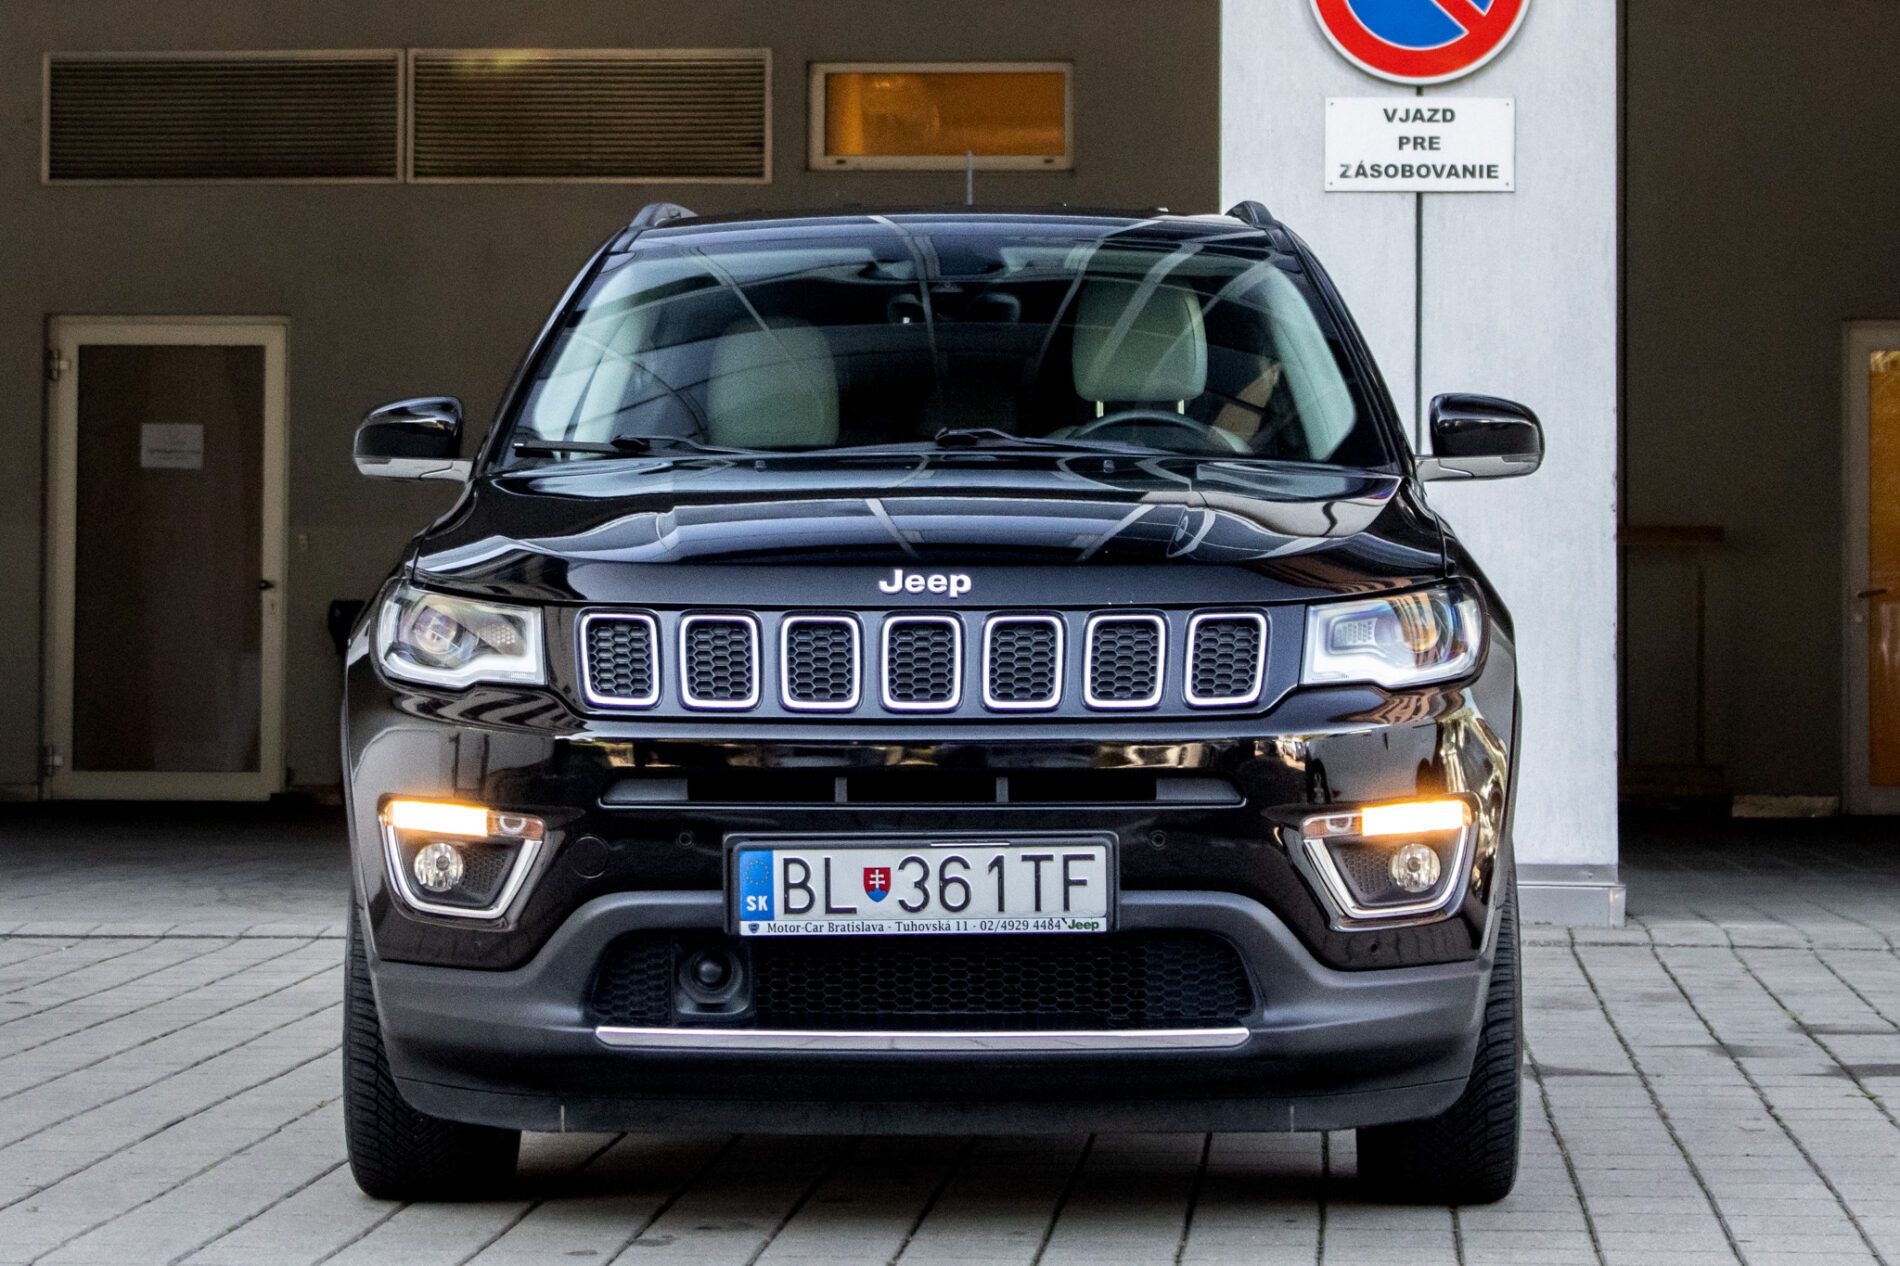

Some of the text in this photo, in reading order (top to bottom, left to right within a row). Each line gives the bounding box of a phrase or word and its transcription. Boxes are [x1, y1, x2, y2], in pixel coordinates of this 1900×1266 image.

[1383, 108, 1456, 123] VJAZD
[1398, 136, 1441, 151] PRE
[1339, 160, 1500, 179] ZÁSOBOVANIE
[878, 568, 972, 598] Jeep
[782, 853, 1096, 915] BL 361TF
[746, 895, 769, 912] SK
[767, 921, 825, 934] Motor-Car
[828, 921, 884, 933] Bratislava
[895, 920, 951, 933] Tuhovská
[956, 920, 968, 931] 11
[980, 919, 1029, 932] 02/4929
[1033, 919, 1061, 931] 4484
[1068, 919, 1100, 931] Jeep
